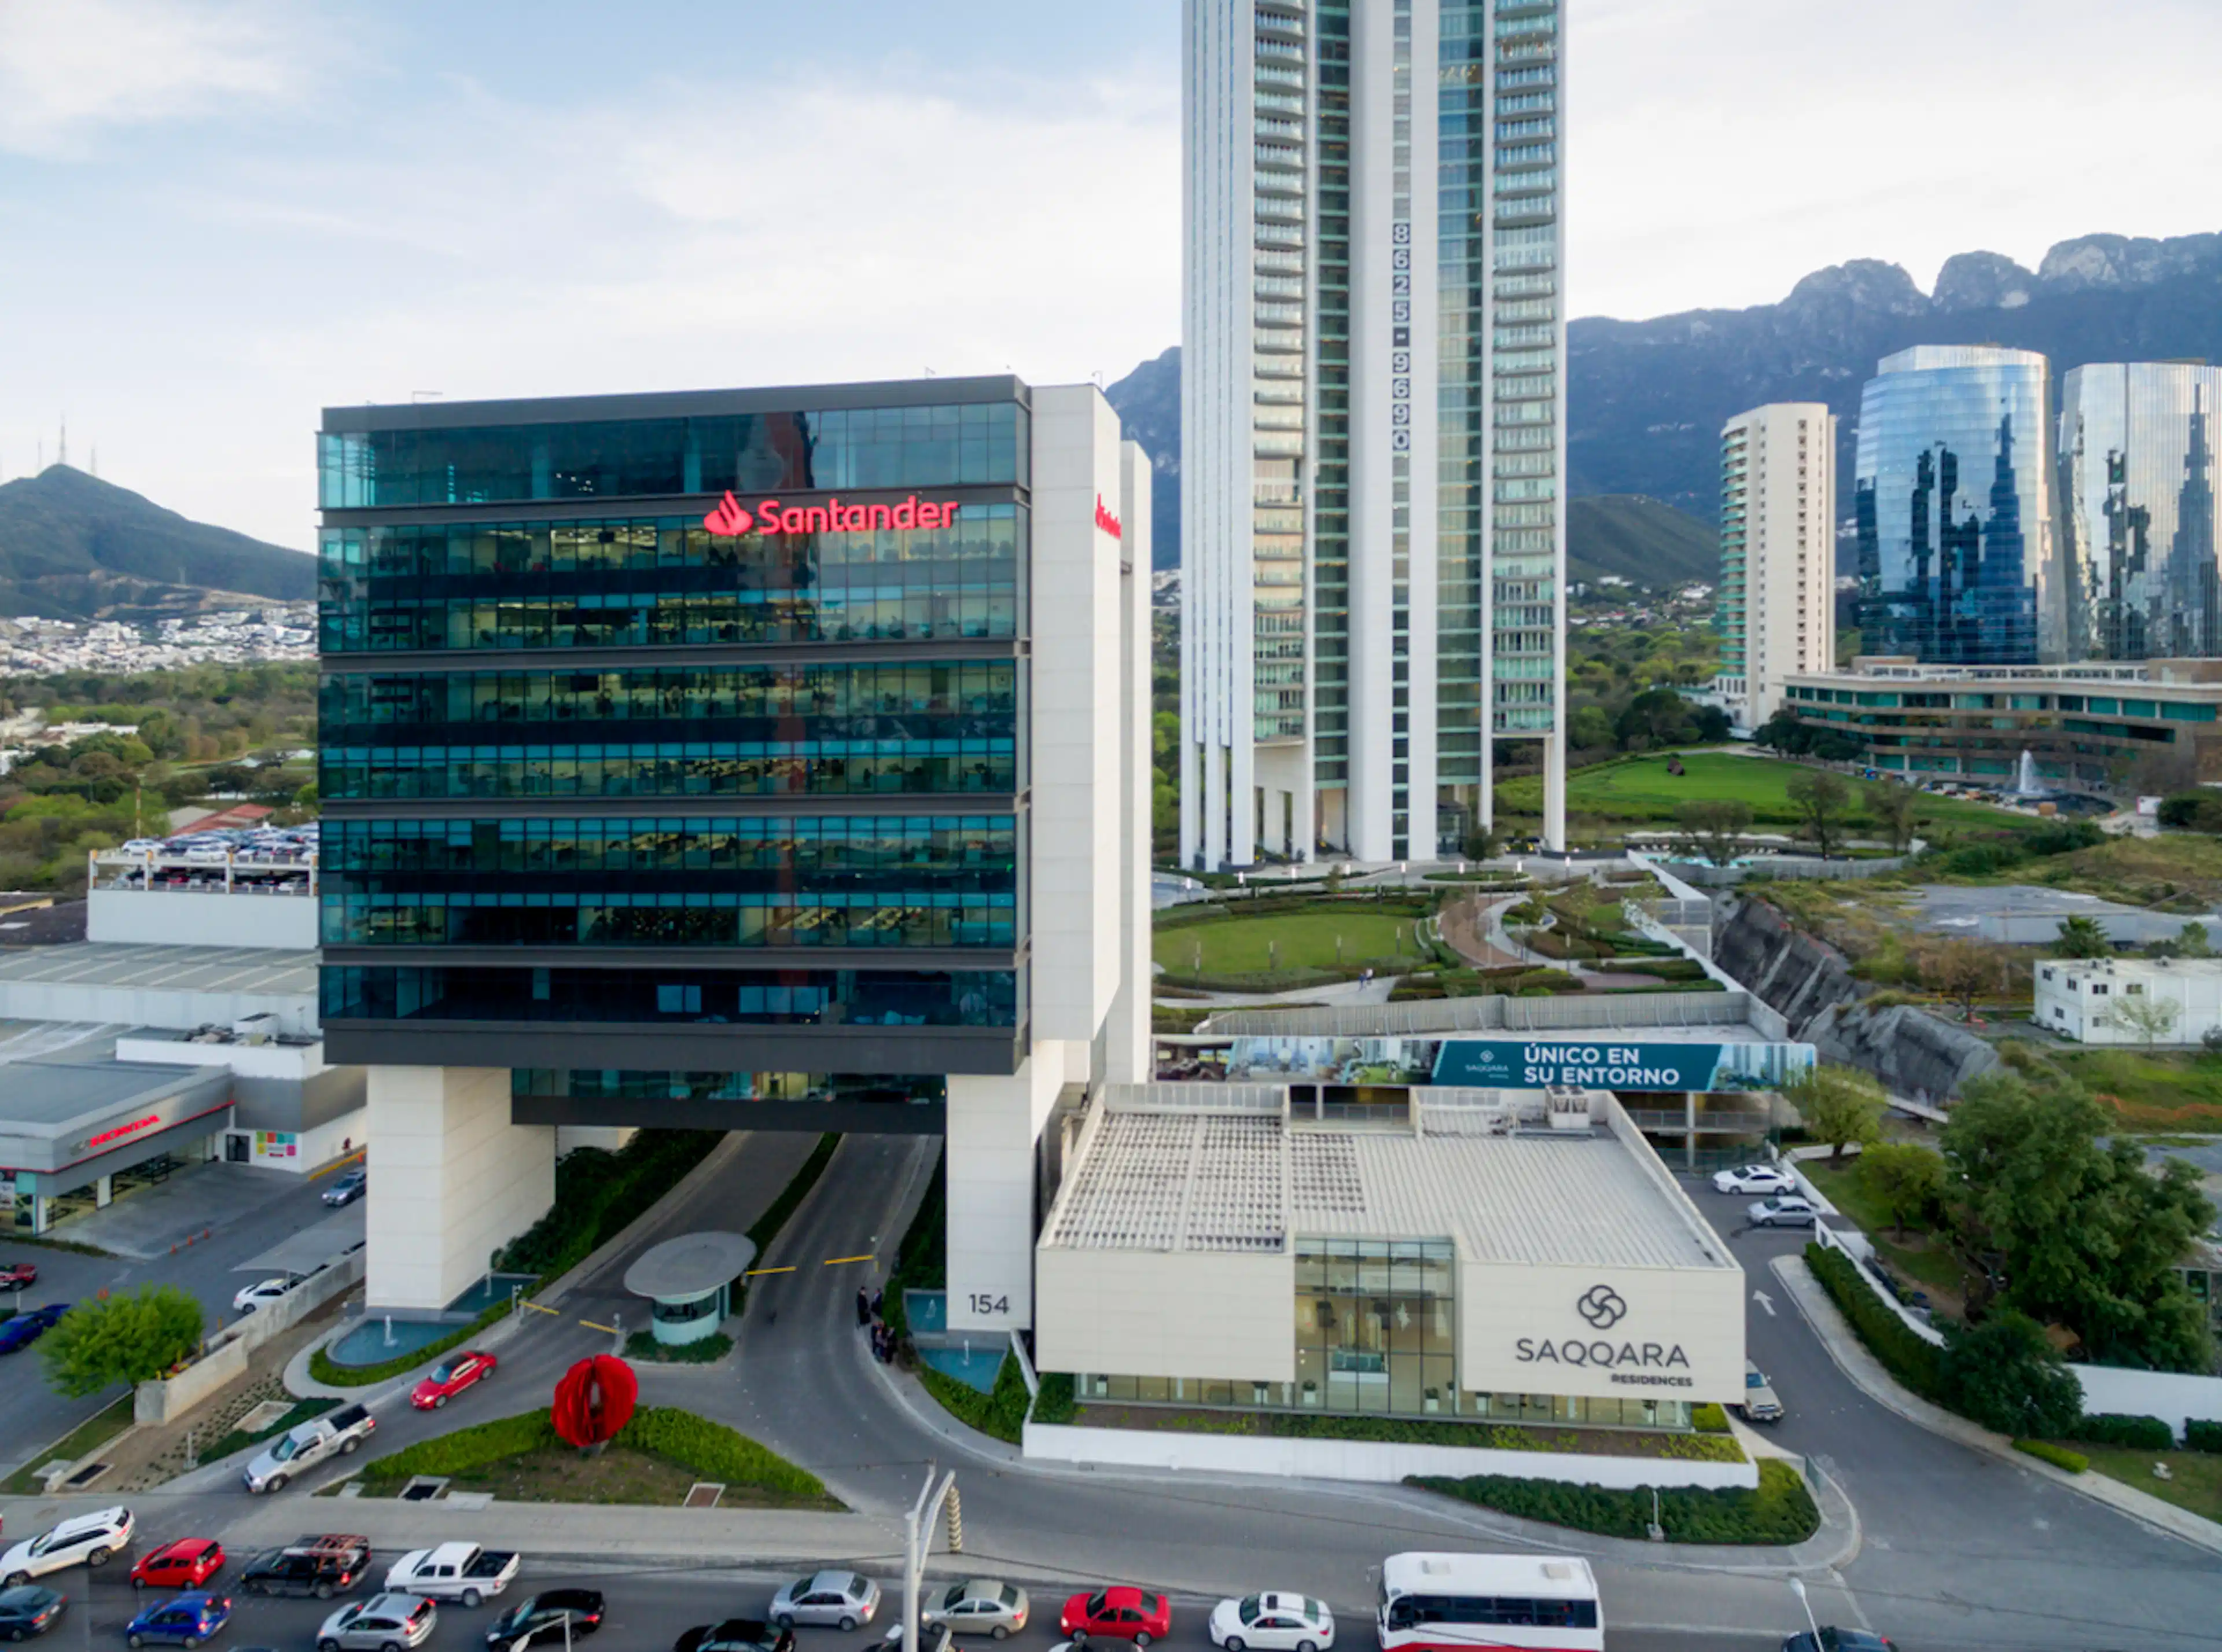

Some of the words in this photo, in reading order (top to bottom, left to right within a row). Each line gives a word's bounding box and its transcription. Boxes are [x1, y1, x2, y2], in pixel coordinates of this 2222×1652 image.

[1393, 223, 1409, 450] 8625-9690
[757, 495, 959, 535] Santander
[1524, 1042, 1601, 1064] ÚNICO
[1607, 1048, 1639, 1065] EN
[1524, 1066, 1554, 1084] SU
[1562, 1067, 1680, 1086] ENTORNO
[89, 1114, 161, 1149] HONDA
[969, 1294, 1009, 1314] 154
[1515, 1338, 1690, 1368] SAQQARA
[1611, 1374, 1693, 1387] RESIDENCES
